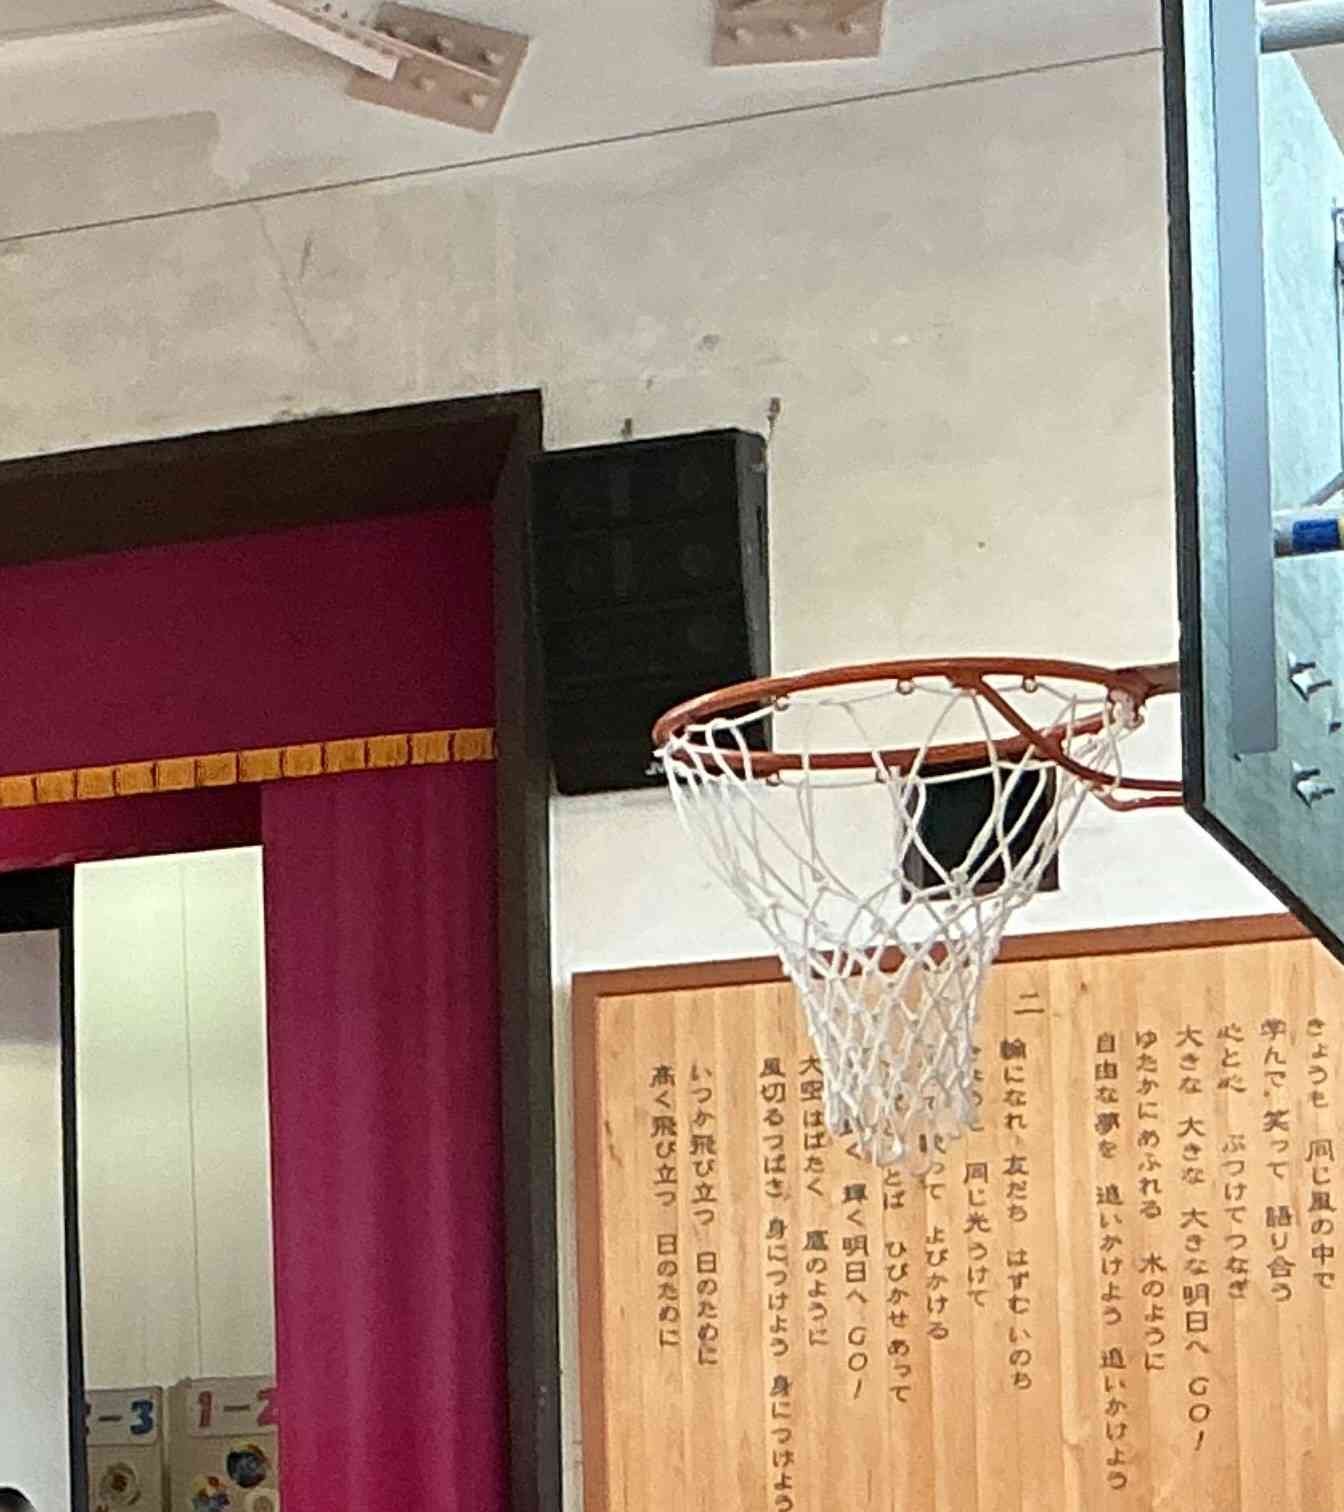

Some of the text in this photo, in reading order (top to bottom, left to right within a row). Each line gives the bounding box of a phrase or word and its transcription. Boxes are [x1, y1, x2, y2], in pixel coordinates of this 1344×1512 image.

[1013, 993, 1045, 1016] 二
[1176, 1024, 1203, 1094] 大きな
[1217, 1022, 1247, 1093] 心と心
[759, 1058, 787, 1198] 風切るつばさ
[1178, 1116, 1205, 1185] 大きな
[1306, 1018, 1336, 1290] きょうも 同じ風の中で
[650, 1063, 681, 1348] 高く飛び立つ 日のために
[689, 1063, 719, 1366] いつか飛び立つ 日のために
[1094, 1032, 1127, 1490] 自由な夢を 追いかけよう 追いかけよう
[1265, 1205, 1295, 1302] 語り合う
[765, 1216, 793, 1358] 身につけよう
[925, 1226, 950, 1341] よびかける
[1140, 1252, 1167, 1372] 水のように
[1181, 1206, 1210, 1354] 大きな明日へ
